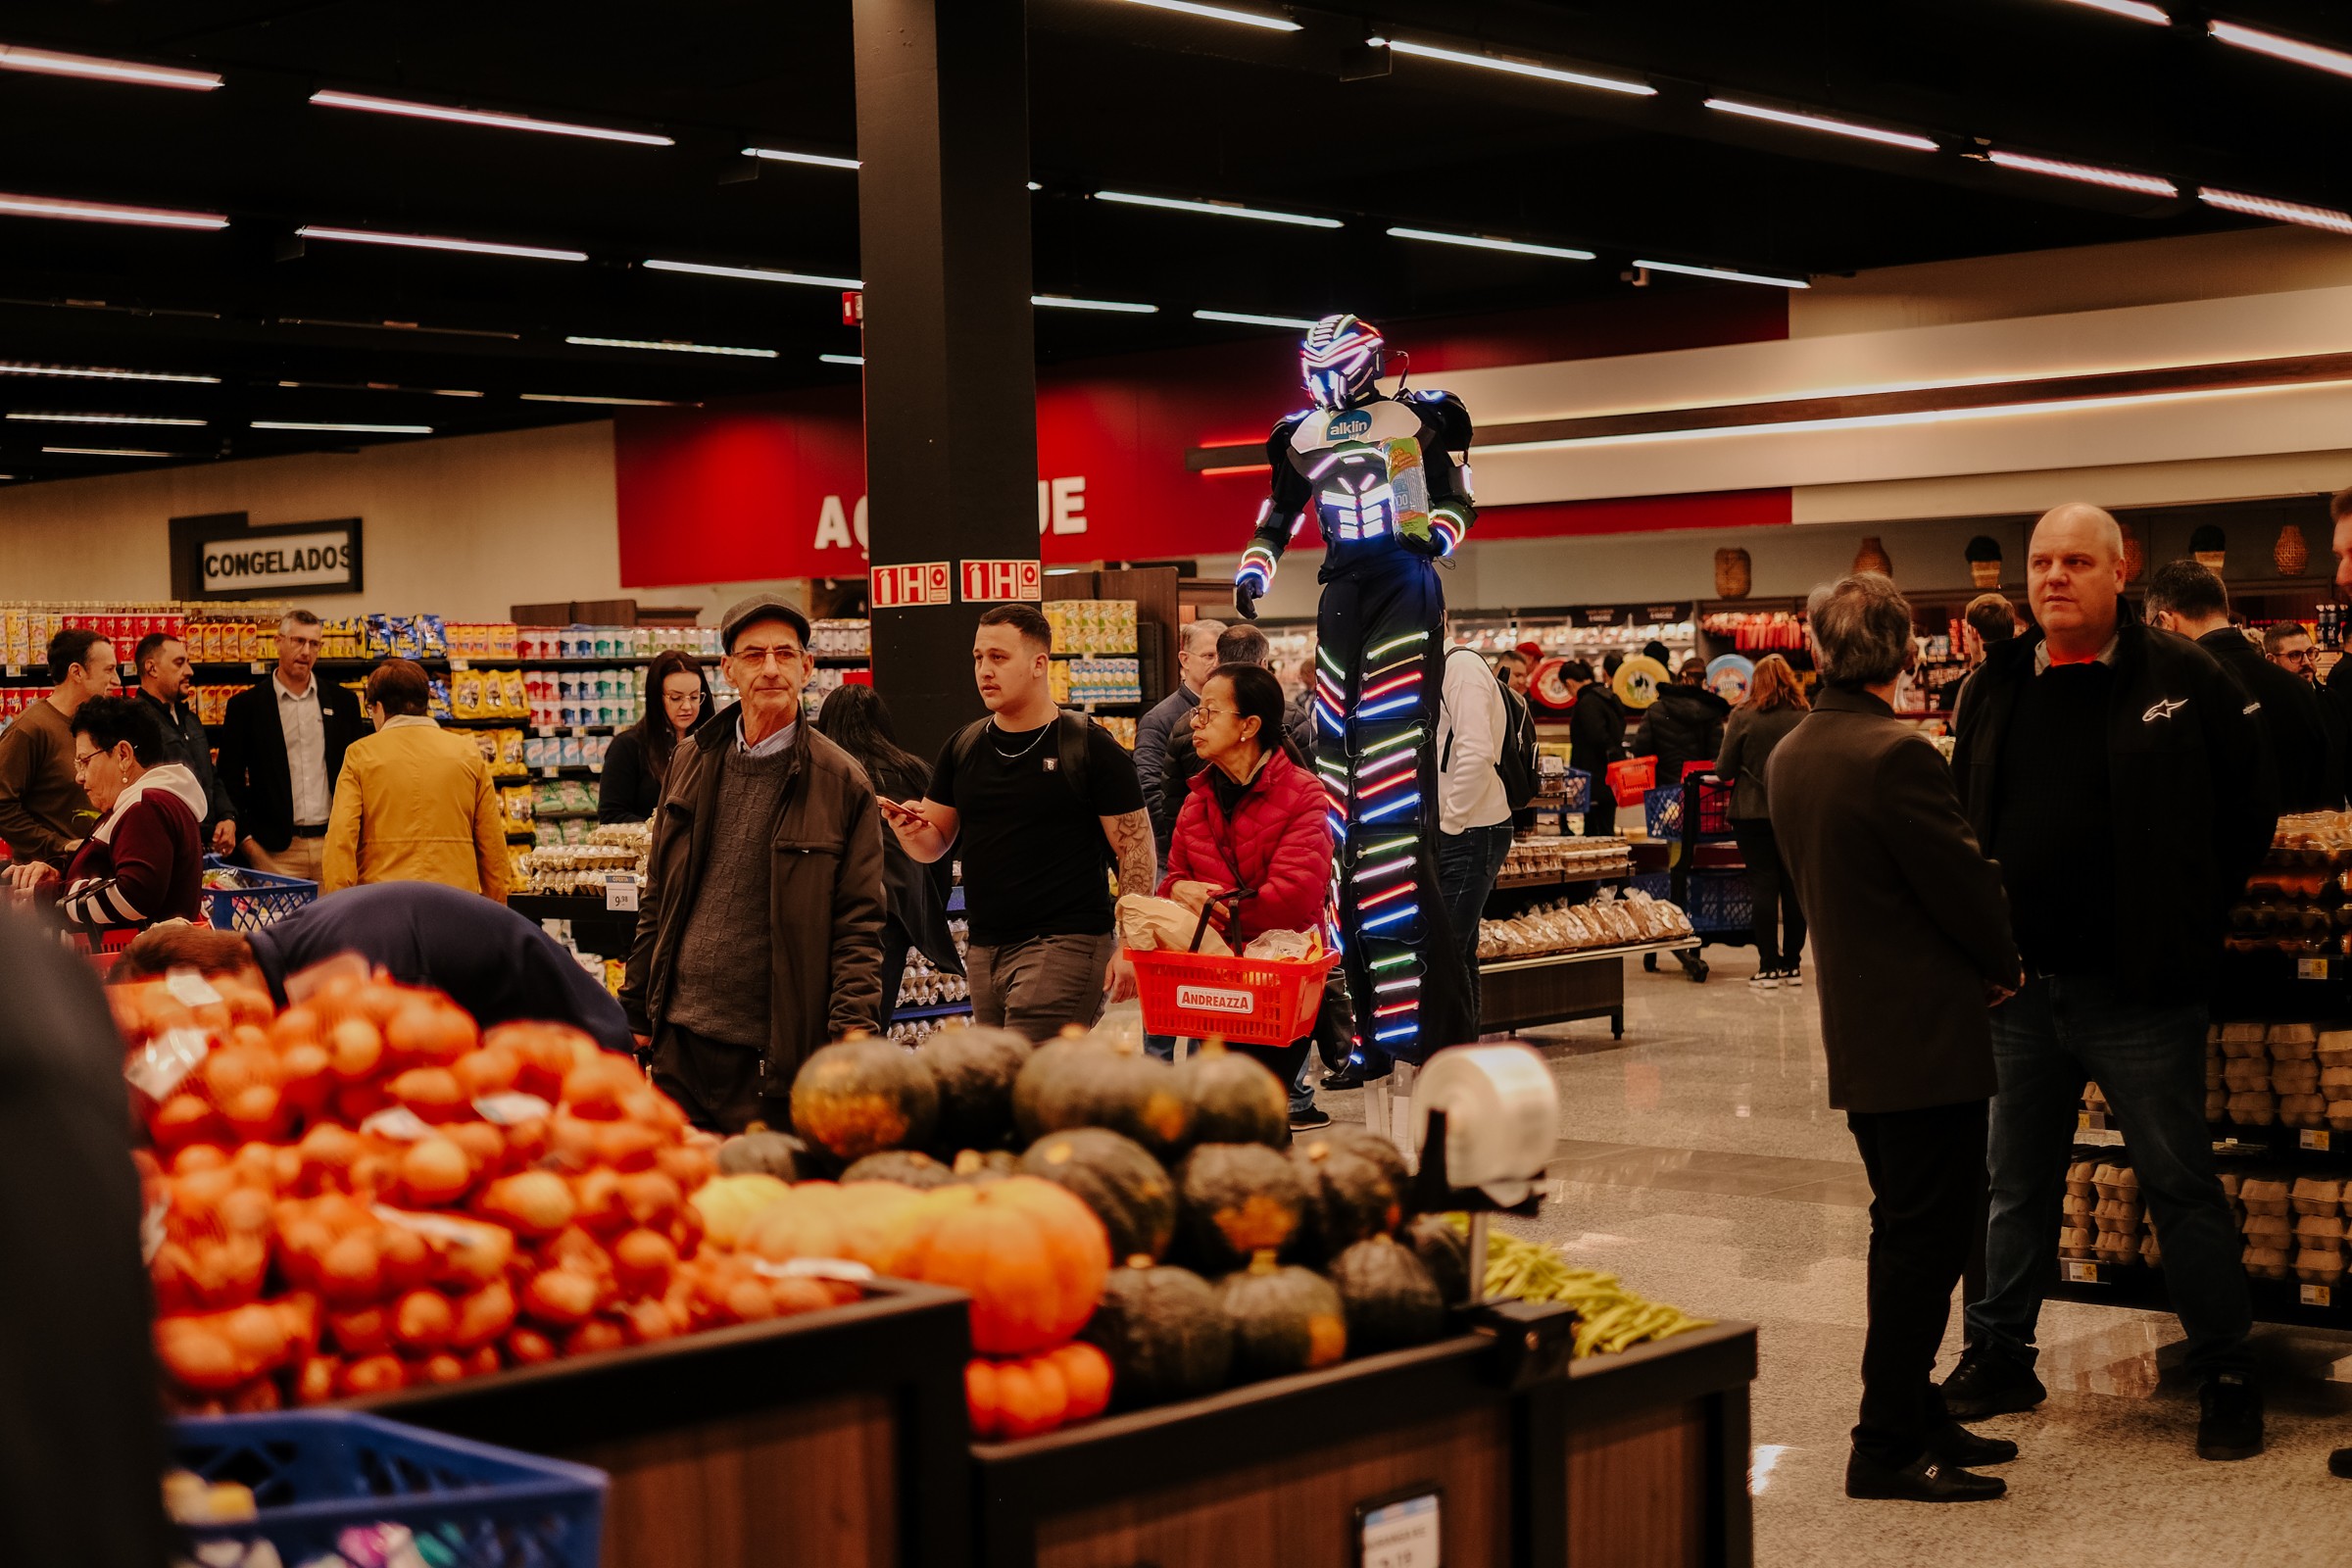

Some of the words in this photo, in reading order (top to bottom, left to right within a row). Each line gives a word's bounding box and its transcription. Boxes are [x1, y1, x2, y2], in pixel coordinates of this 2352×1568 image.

[1330, 419, 1368, 436] alklin
[204, 545, 350, 577] CONGELADOS
[1181, 991, 1249, 1009] ANDREAZZA
